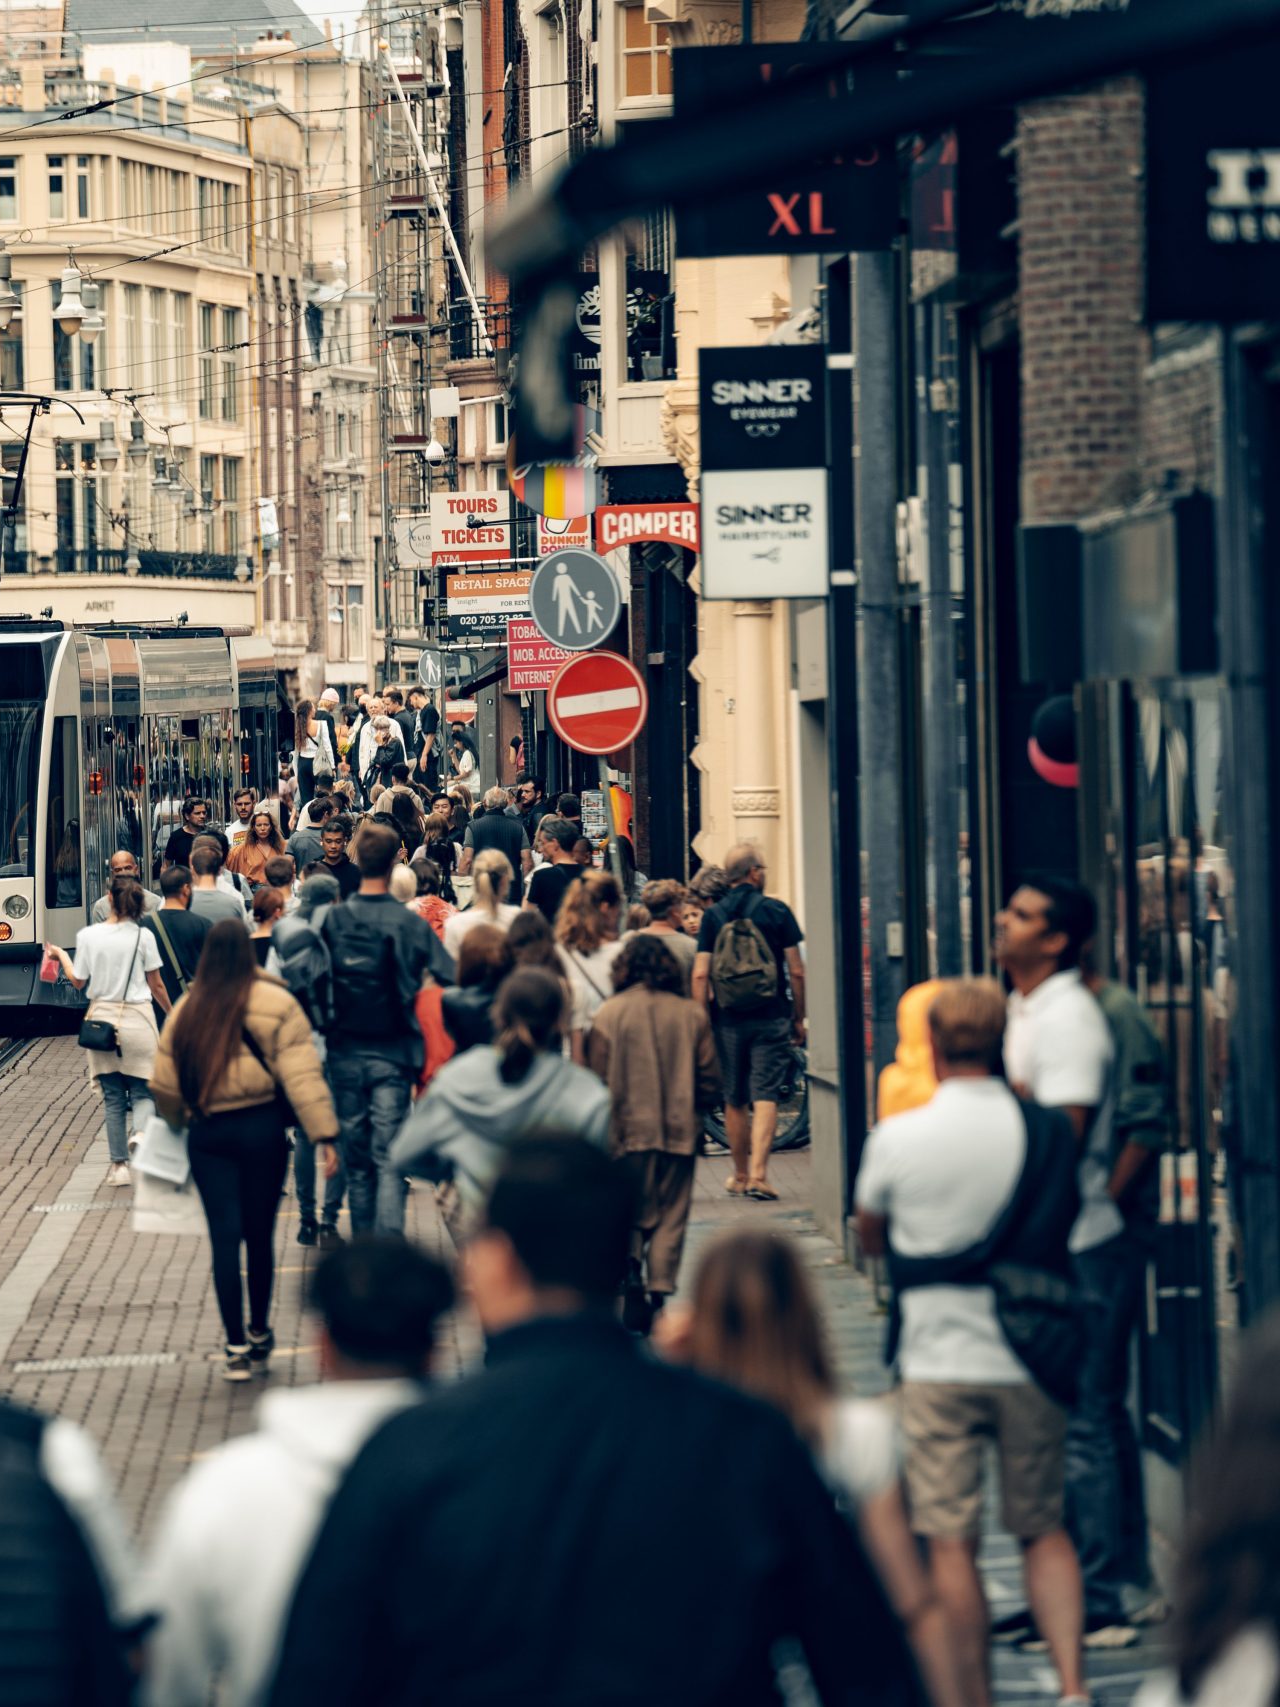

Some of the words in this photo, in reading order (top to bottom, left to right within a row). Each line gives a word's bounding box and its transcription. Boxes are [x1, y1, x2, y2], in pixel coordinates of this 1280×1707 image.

[767, 191, 836, 236] XL
[712, 378, 812, 405] SINNER
[730, 406, 798, 421] EYEWEAR
[447, 498, 498, 514] TOURS
[716, 503, 812, 526] SINNER
[602, 510, 698, 545] CAMPER
[441, 528, 505, 545] TICKETS
[540, 535, 588, 546] DUNKIN'
[435, 554, 460, 565] ATM
[453, 579, 493, 591] RETAIL
[495, 577, 531, 589] SPACE
[460, 616, 478, 625] 020
[479, 616, 497, 624] 705
[511, 625, 542, 639] TOBAC
[513, 648, 537, 662] MOB.
[513, 670, 556, 685] INTERNET
